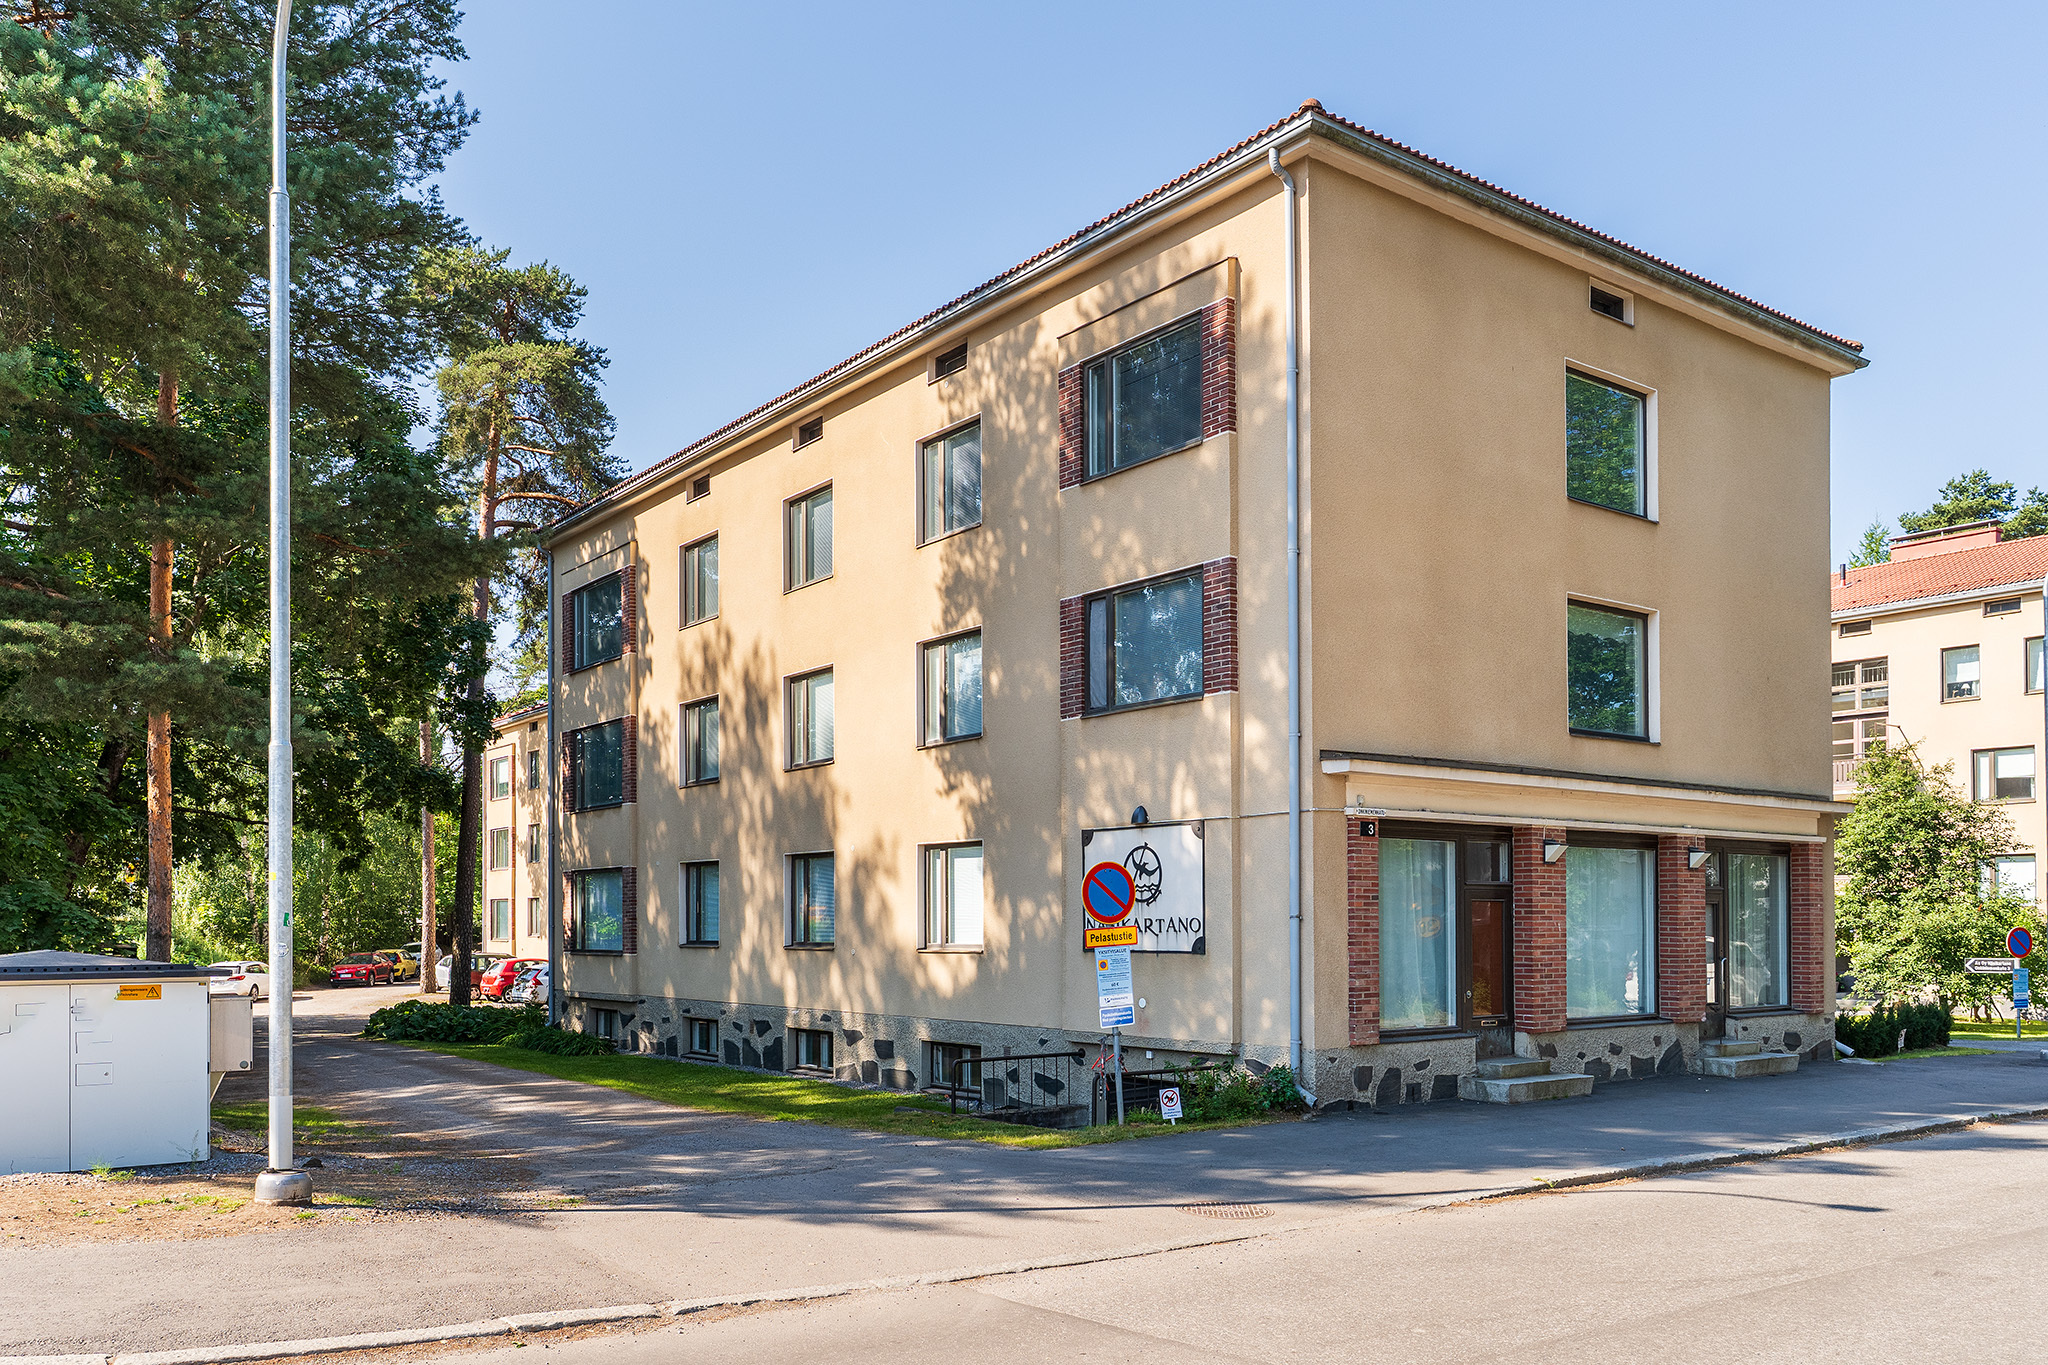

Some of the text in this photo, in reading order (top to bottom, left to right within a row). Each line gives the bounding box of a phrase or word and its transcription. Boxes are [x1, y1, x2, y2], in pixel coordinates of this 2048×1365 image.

[1368, 824, 1374, 835] 3
[1087, 917, 1202, 937] NKARTANO
[1090, 931, 1133, 943] Pelastustie
